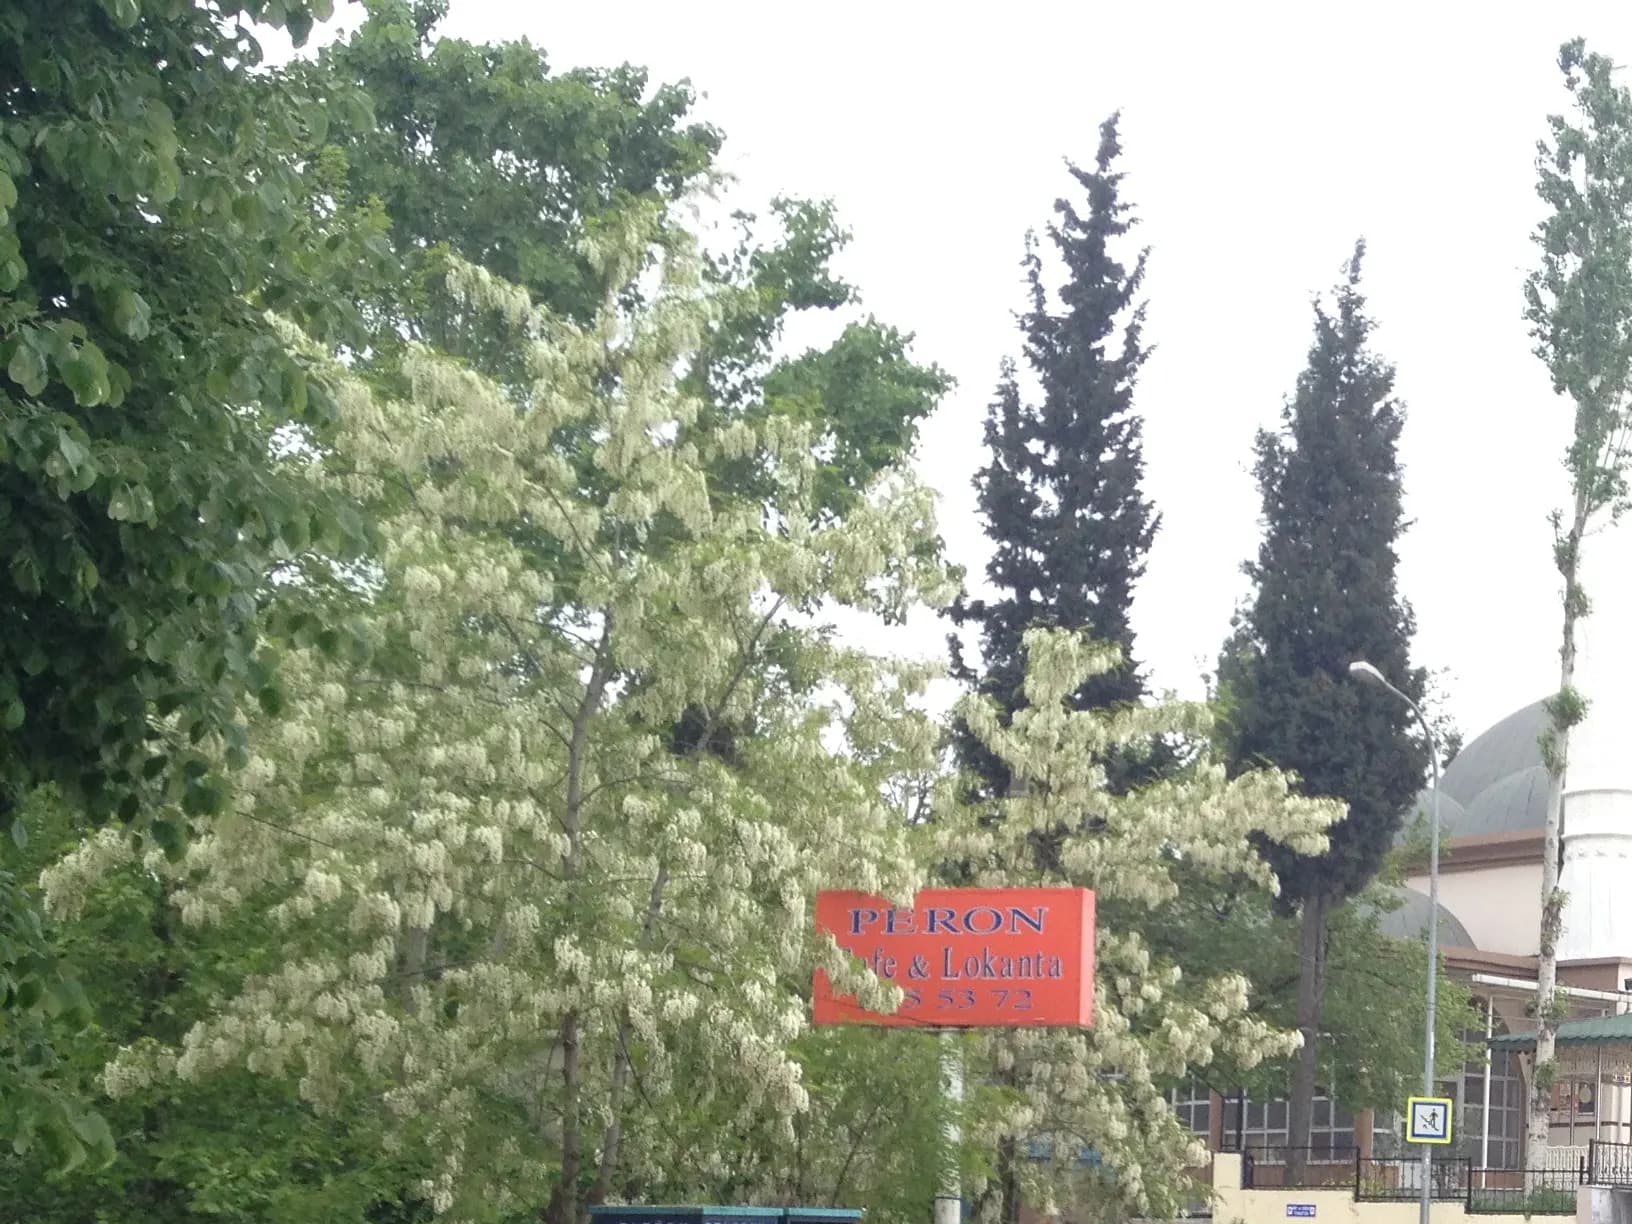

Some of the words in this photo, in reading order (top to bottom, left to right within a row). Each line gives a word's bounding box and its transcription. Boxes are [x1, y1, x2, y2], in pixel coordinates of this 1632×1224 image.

[848, 907, 1049, 935] PERON
[908, 957, 930, 979] &
[941, 946, 1062, 980] Lokanta
[937, 989, 977, 1009] 53
[991, 989, 1033, 1010] 72
